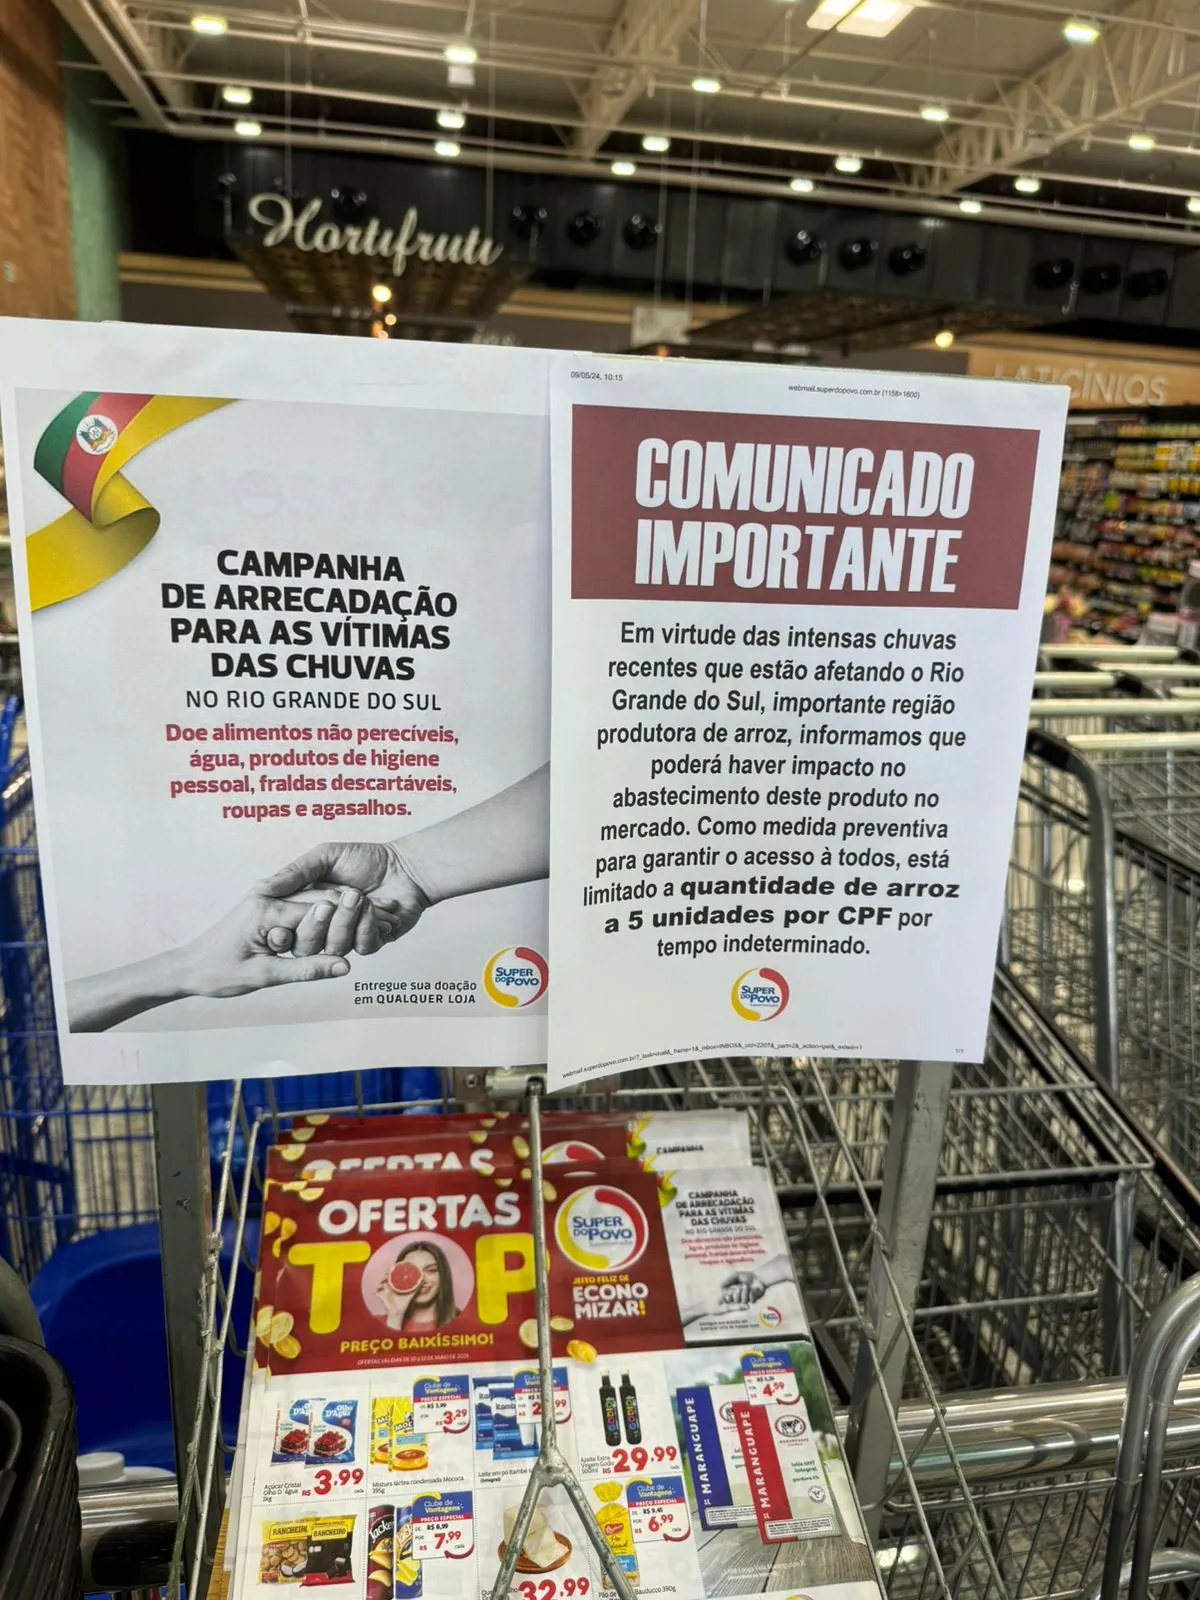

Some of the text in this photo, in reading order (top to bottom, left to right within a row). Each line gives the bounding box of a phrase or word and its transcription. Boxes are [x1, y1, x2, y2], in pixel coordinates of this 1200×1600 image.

[249, 193, 504, 277] Hortifruti
[570, 371, 623, 381] 09/05/24, 10:15
[636, 438, 974, 518] COMUNICADO
[217, 549, 405, 582] CAMPANHA
[635, 519, 962, 592] IMPORTANTE
[161, 583, 457, 622] DE ARRECADAÇÃO
[171, 616, 450, 650] PARA AS VÍTIMAS
[621, 622, 956, 650] Em virtude das intensas chuvas
[211, 653, 415, 680] DAS CHUVAS
[609, 657, 964, 683] recentes que estão afetando o Rio
[186, 690, 441, 709] NO RIO GRANDE DO SUL
[612, 689, 955, 719] Grande do Sul, importante região
[165, 723, 459, 745] Doe alimentos não perecíveis,
[597, 722, 966, 751] produtora de arroz, informamos que
[190, 749, 440, 772] água, produtos de higiene
[651, 754, 906, 780] poderá haver impacto no
[170, 774, 457, 798] pessoal, fraldas descartáveis,
[613, 785, 939, 811] abastecimento deste produto no
[223, 799, 412, 822] roupas e agasalhos.
[601, 816, 948, 841] mercado. Como medida preventiva
[596, 846, 949, 878] para garantir o acesso à todos, está
[583, 876, 960, 906] limitado a quantidade de arroz
[605, 905, 933, 933] a 5 unidades por CPF por
[657, 934, 870, 959] tempo indeterminado.
[495, 967, 533, 977] SUPER
[507, 977, 539, 987] POVO
[354, 980, 477, 993] Entregue sua doação
[741, 985, 775, 995] SUPER
[354, 994, 476, 1005] em QUALQUER LOJA
[750, 994, 780, 1003] POVO
[676, 1200, 688, 1209] DE
[688, 1189, 738, 1199] CAMPANHA
[318, 1191, 521, 1236] OFERTAS
[572, 1216, 623, 1229] SUPER
[679, 1206, 755, 1218] PARA AS VÍTIMAS
[691, 1216, 747, 1226] DAS CHUVAS
[588, 1228, 633, 1240] POVO
[619, 1274, 629, 1282] DE
[572, 1282, 649, 1302] ECONO
[574, 1299, 647, 1320] MIZAR!
[340, 1333, 494, 1354] PREÇO BAIXÍSSIMO!
[684, 1398, 712, 1494] MARANGUAPE
[612, 1445, 677, 1473] 29,99
[740, 1411, 771, 1508] MARANGUAPE
[648, 1514, 674, 1532] 6,99
[434, 1530, 462, 1550] 7,99
